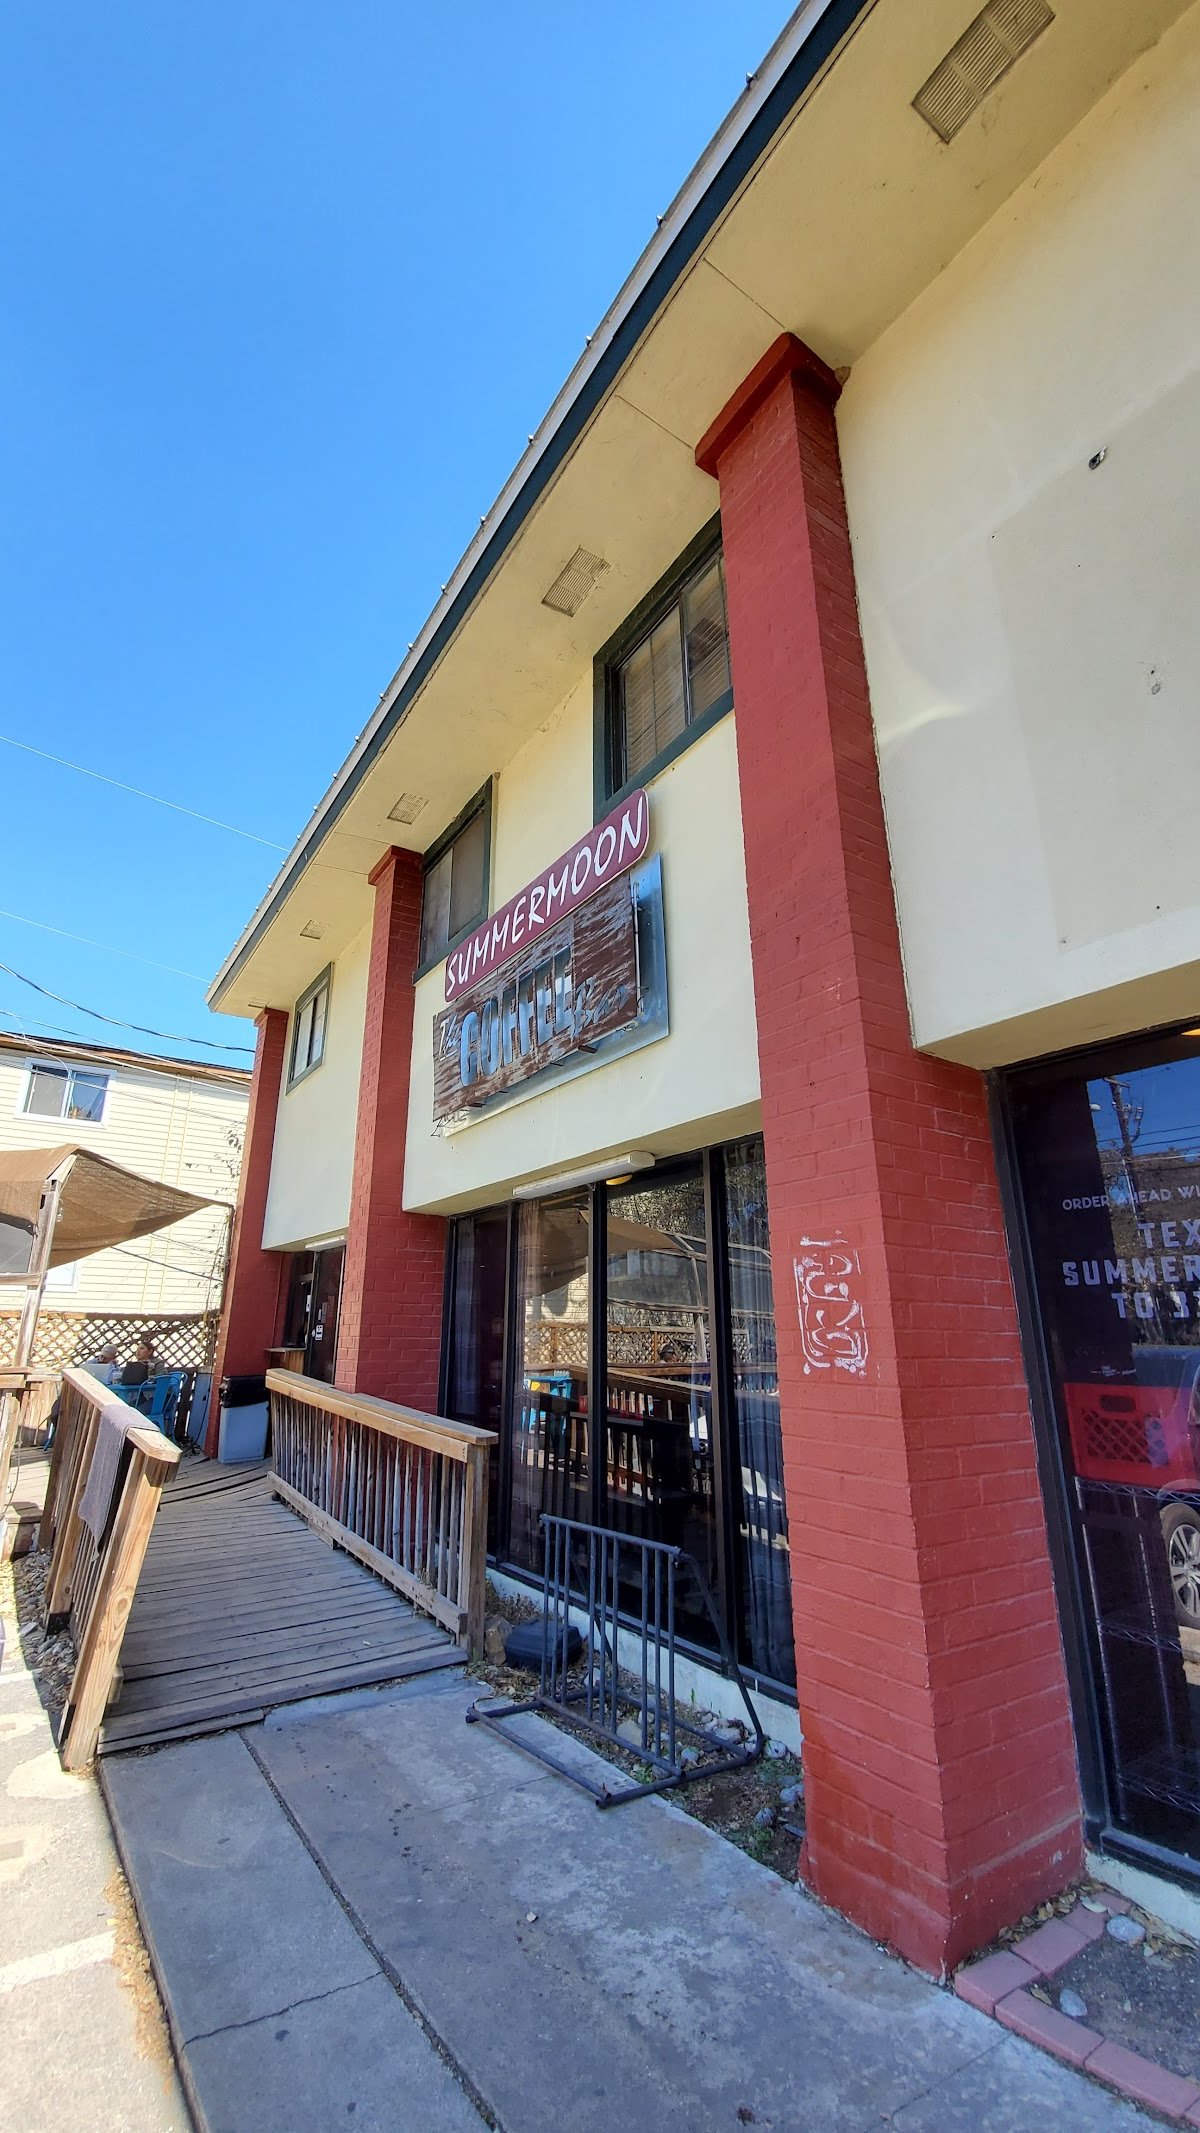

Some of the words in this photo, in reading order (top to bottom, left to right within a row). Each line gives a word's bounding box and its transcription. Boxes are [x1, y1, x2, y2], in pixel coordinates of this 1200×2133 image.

[446, 796, 643, 997] SUMMERMOON
[439, 1013, 462, 1062] The
[460, 945, 574, 1087] COFFEE
[1062, 1195, 1110, 1211] ORDER
[1116, 1188, 1172, 1206] AHEAD
[1111, 1291, 1154, 1319] TO
